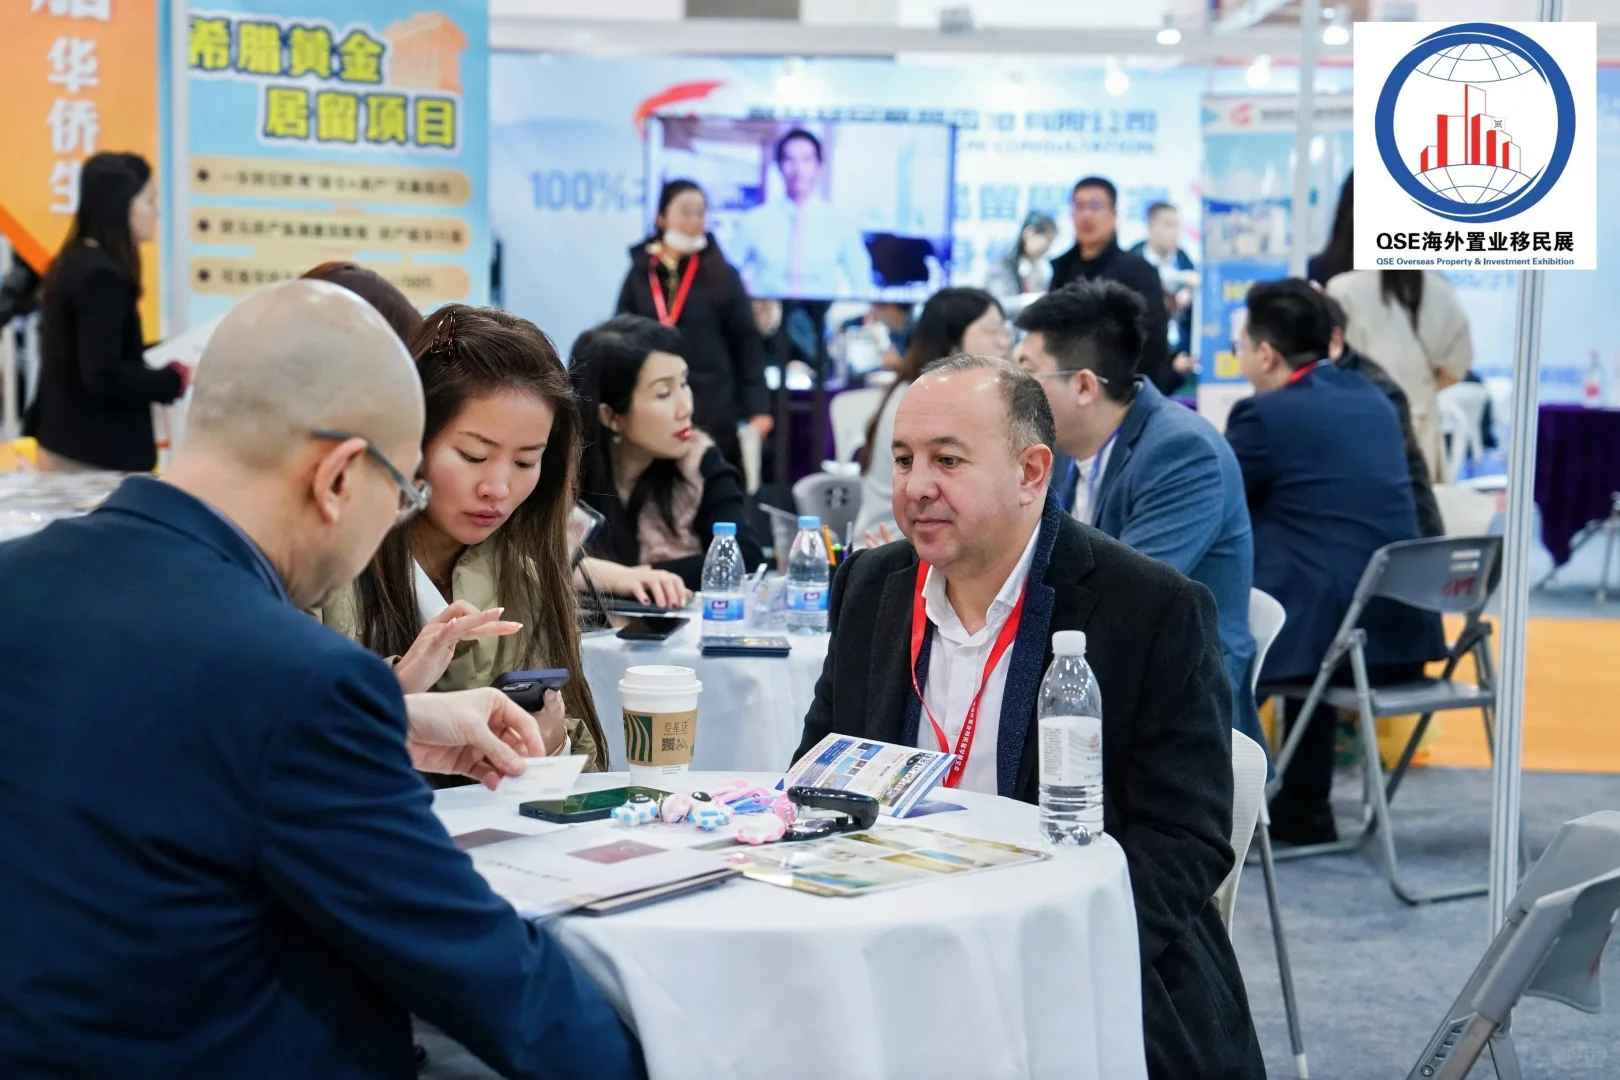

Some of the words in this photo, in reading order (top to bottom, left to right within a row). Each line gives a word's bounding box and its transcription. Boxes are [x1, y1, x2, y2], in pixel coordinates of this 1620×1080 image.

[264, 86, 456, 148] 居留项目
[664, 720, 688, 733] 专星送
